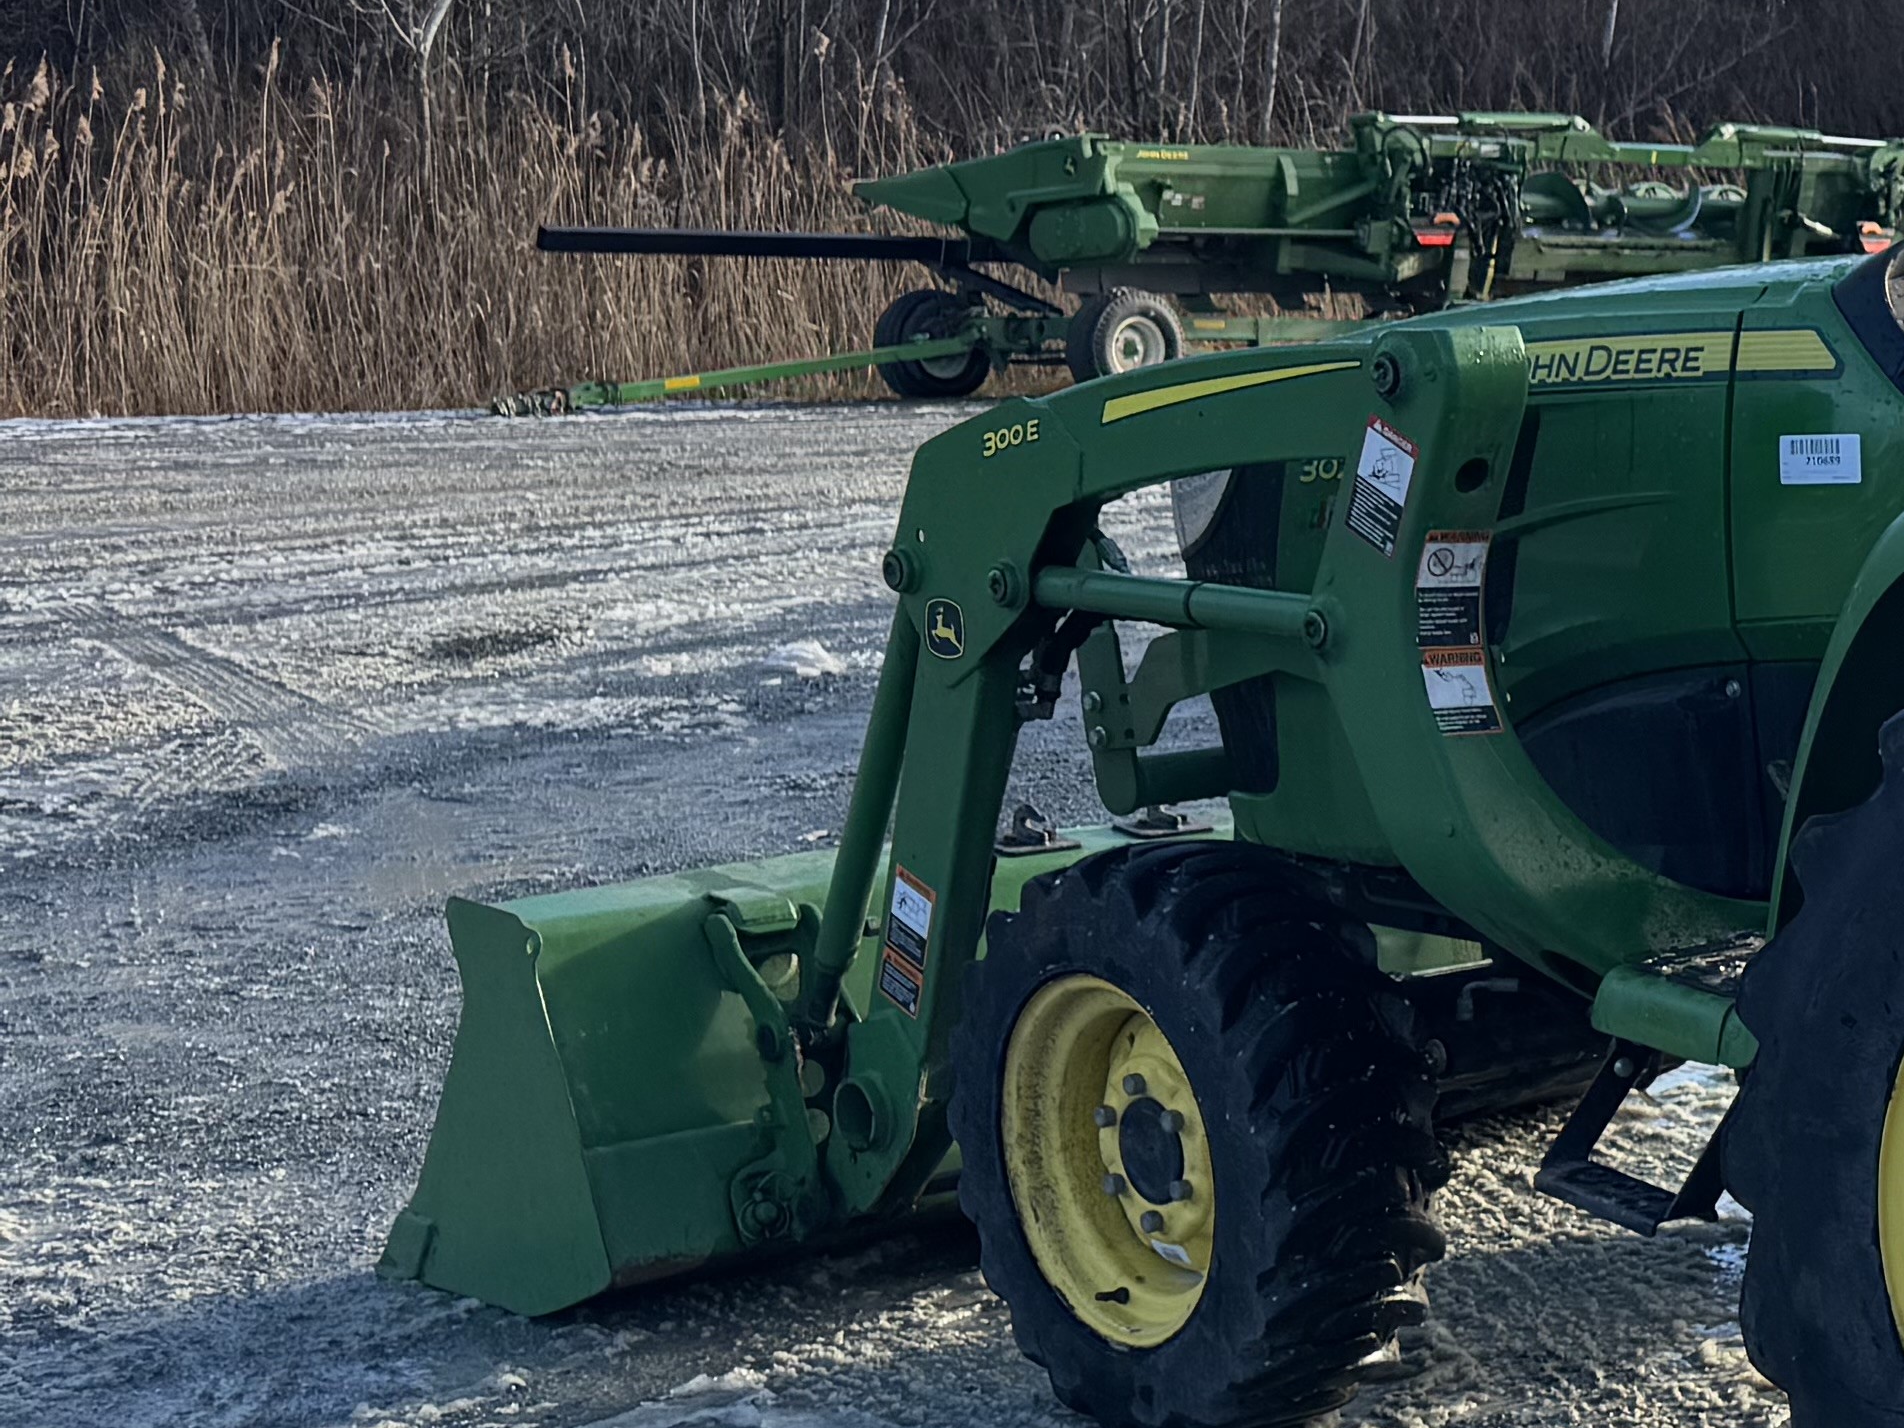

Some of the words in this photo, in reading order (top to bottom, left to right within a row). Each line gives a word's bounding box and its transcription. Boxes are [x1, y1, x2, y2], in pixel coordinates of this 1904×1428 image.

[1527, 351, 1580, 380] HN
[1584, 345, 1705, 378] DEERE
[983, 424, 1024, 458] 300
[1026, 418, 1040, 442] E
[1429, 651, 1482, 666] WARNING
